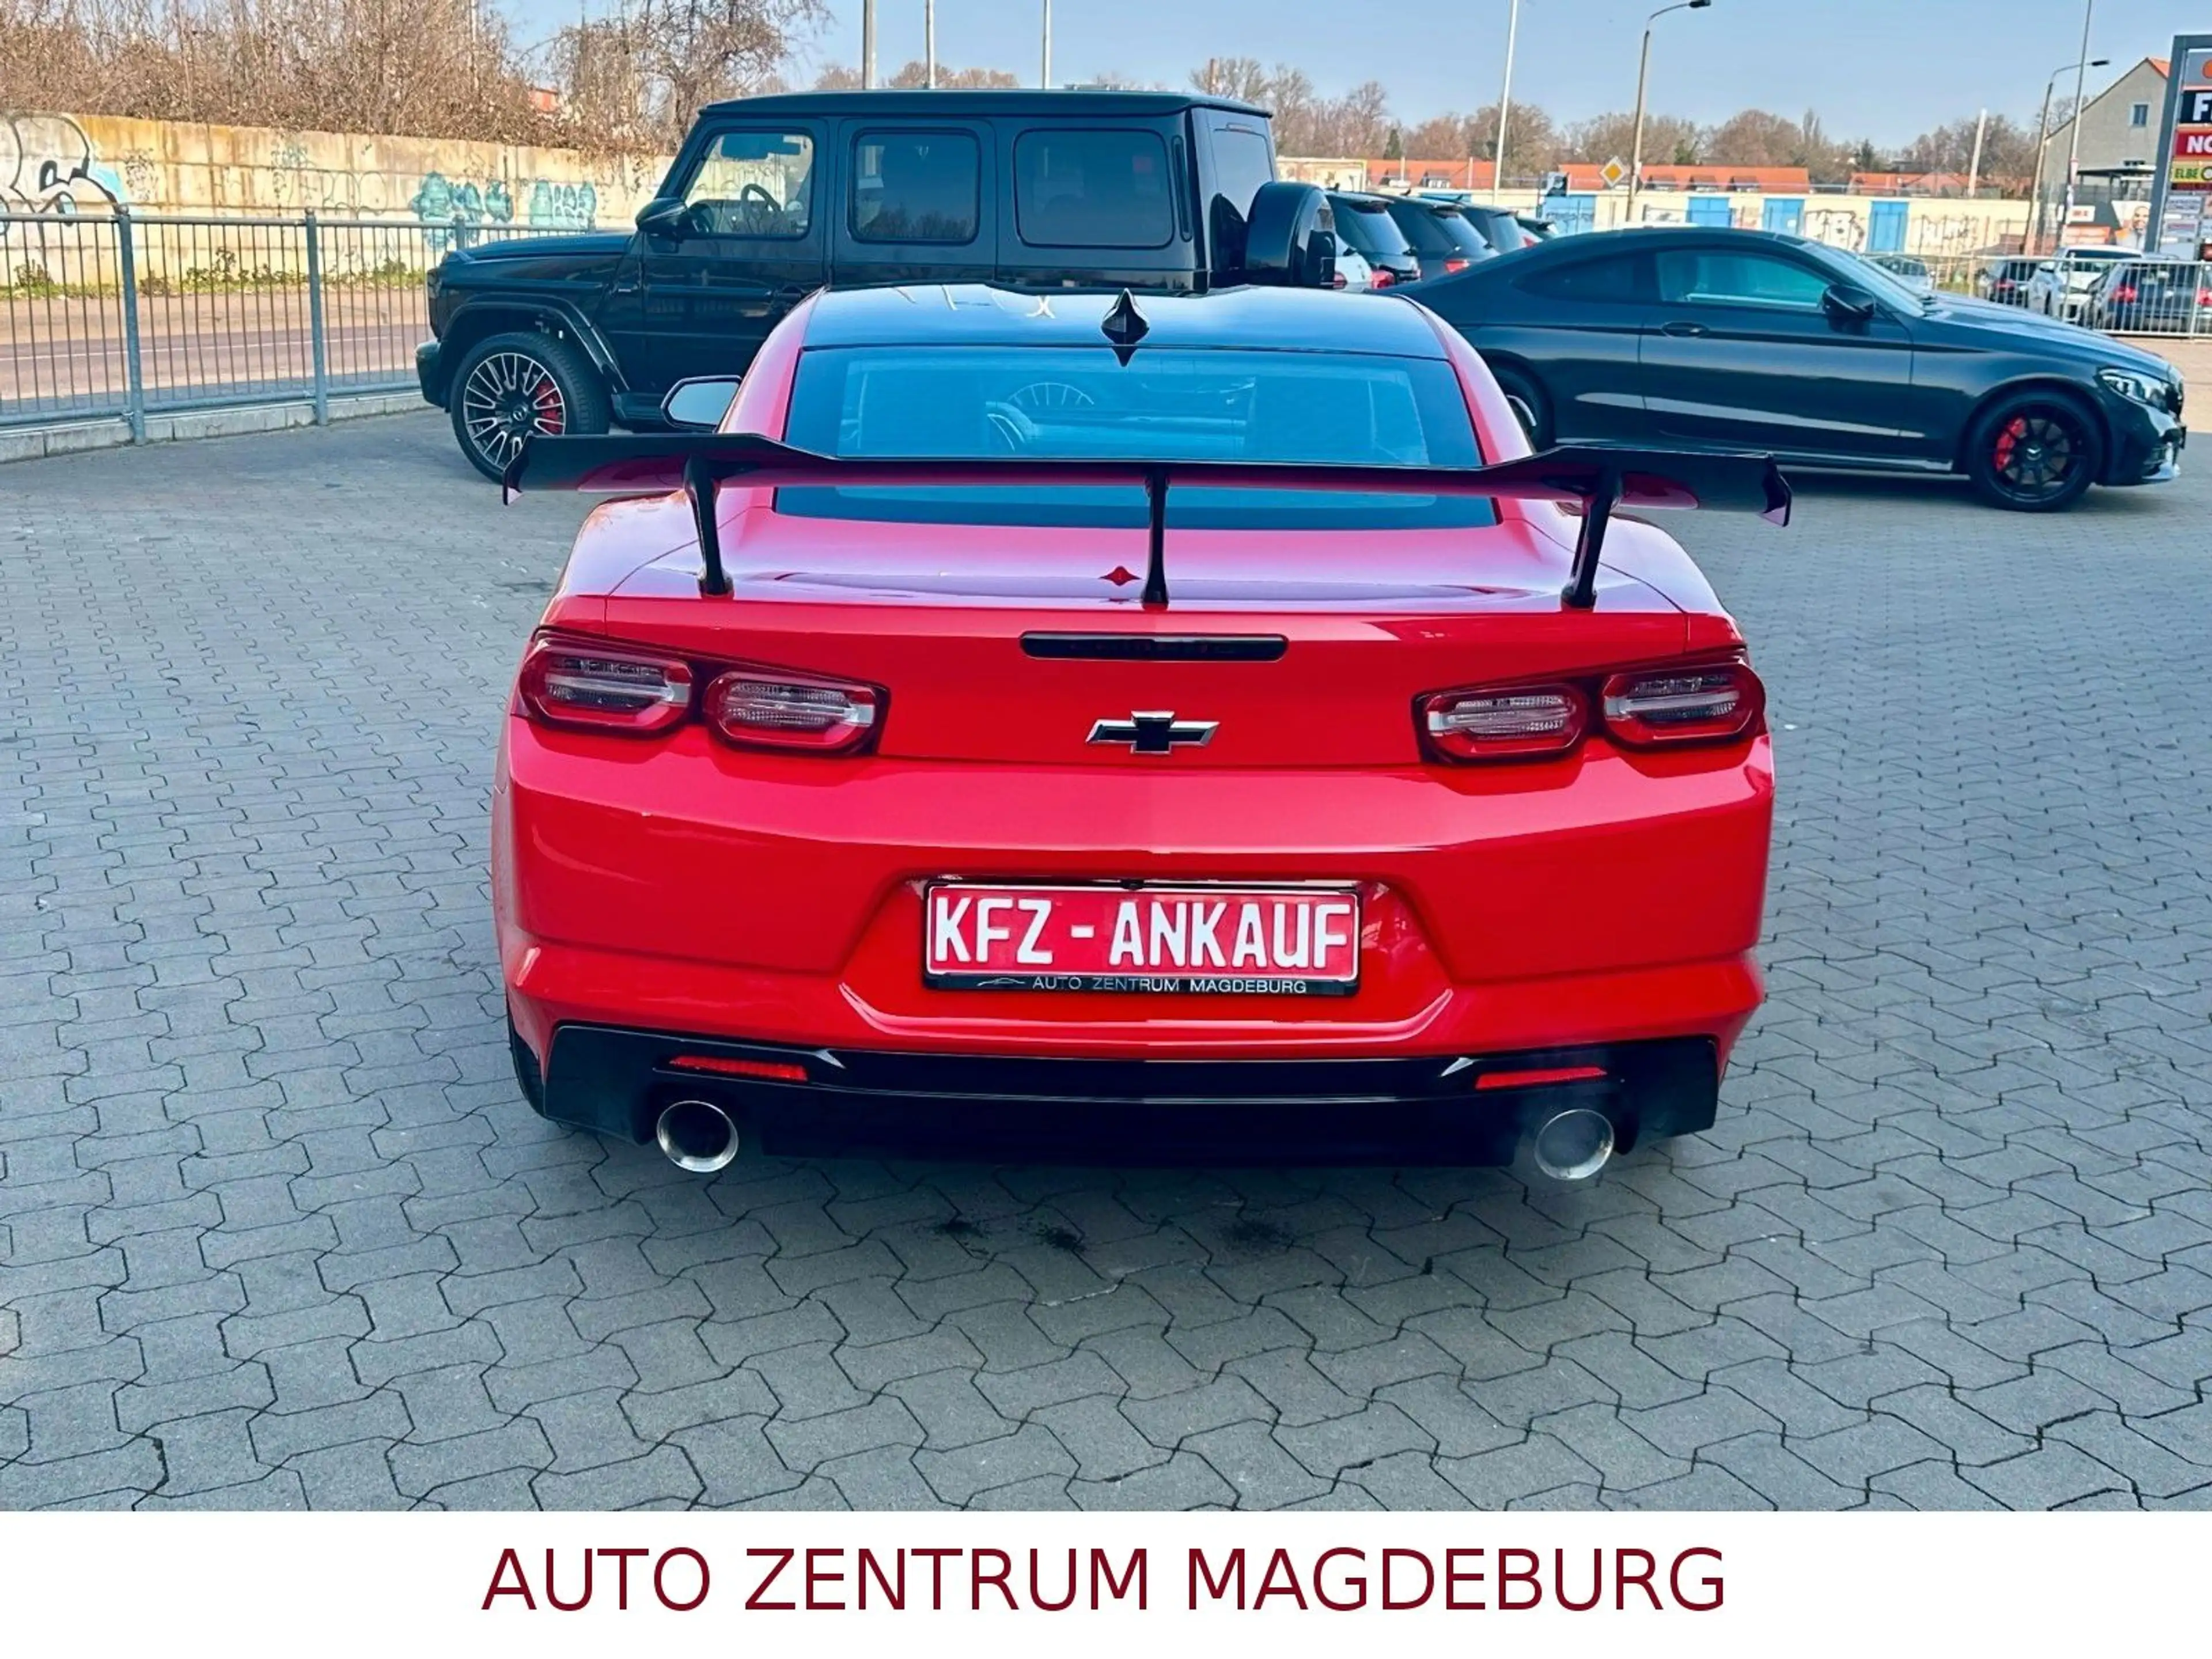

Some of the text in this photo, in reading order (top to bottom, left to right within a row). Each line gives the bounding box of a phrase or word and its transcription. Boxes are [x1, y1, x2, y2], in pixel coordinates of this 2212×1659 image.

[934, 896, 1053, 964] KFZ
[1109, 901, 1352, 968] ANKAUF
[1032, 976, 1307, 994] AUTO ZENTRUM MAGDEBURG
